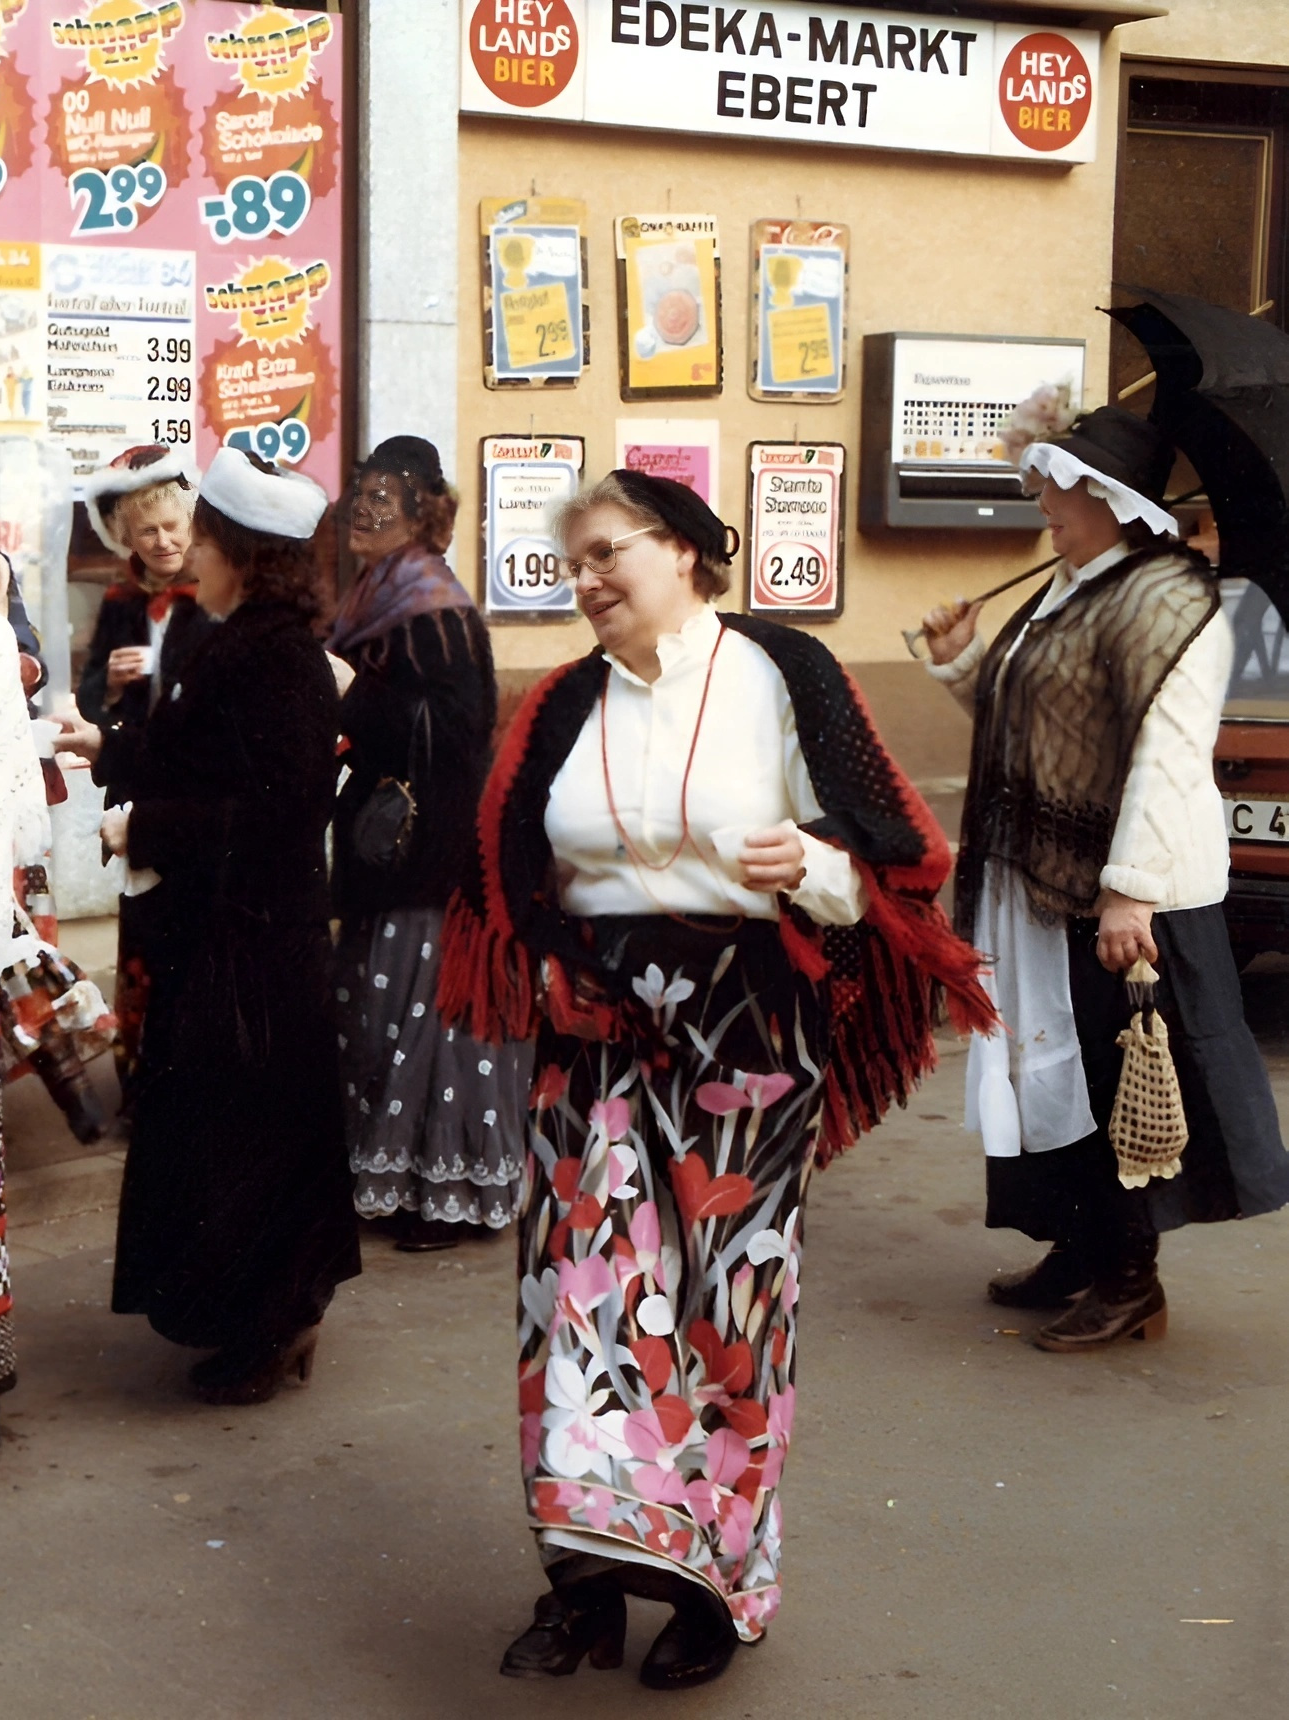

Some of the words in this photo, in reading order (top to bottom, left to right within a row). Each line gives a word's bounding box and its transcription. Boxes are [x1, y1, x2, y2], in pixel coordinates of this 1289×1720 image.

[494, 0, 554, 27] HEY
[479, 25, 571, 57] LANDS
[611, 0, 978, 76] EDEKA-MARKT
[494, 56, 556, 86] BIER
[1020, 50, 1072, 77] HEY
[62, 90, 89, 113] 00
[717, 70, 877, 128] EBERT
[1006, 74, 1086, 105] LANDS
[65, 110, 105, 136] Null
[111, 106, 151, 134] Null
[1018, 105, 1072, 131] BIER
[70, 166, 164, 231] 2.99
[147, 337, 192, 363] 3.99
[147, 376, 192, 402] 2.99
[151, 419, 192, 444] 1.59
[505, 552, 560, 588] 1.99
[769, 556, 821, 588] 2.49
[1232, 803, 1254, 835] C
